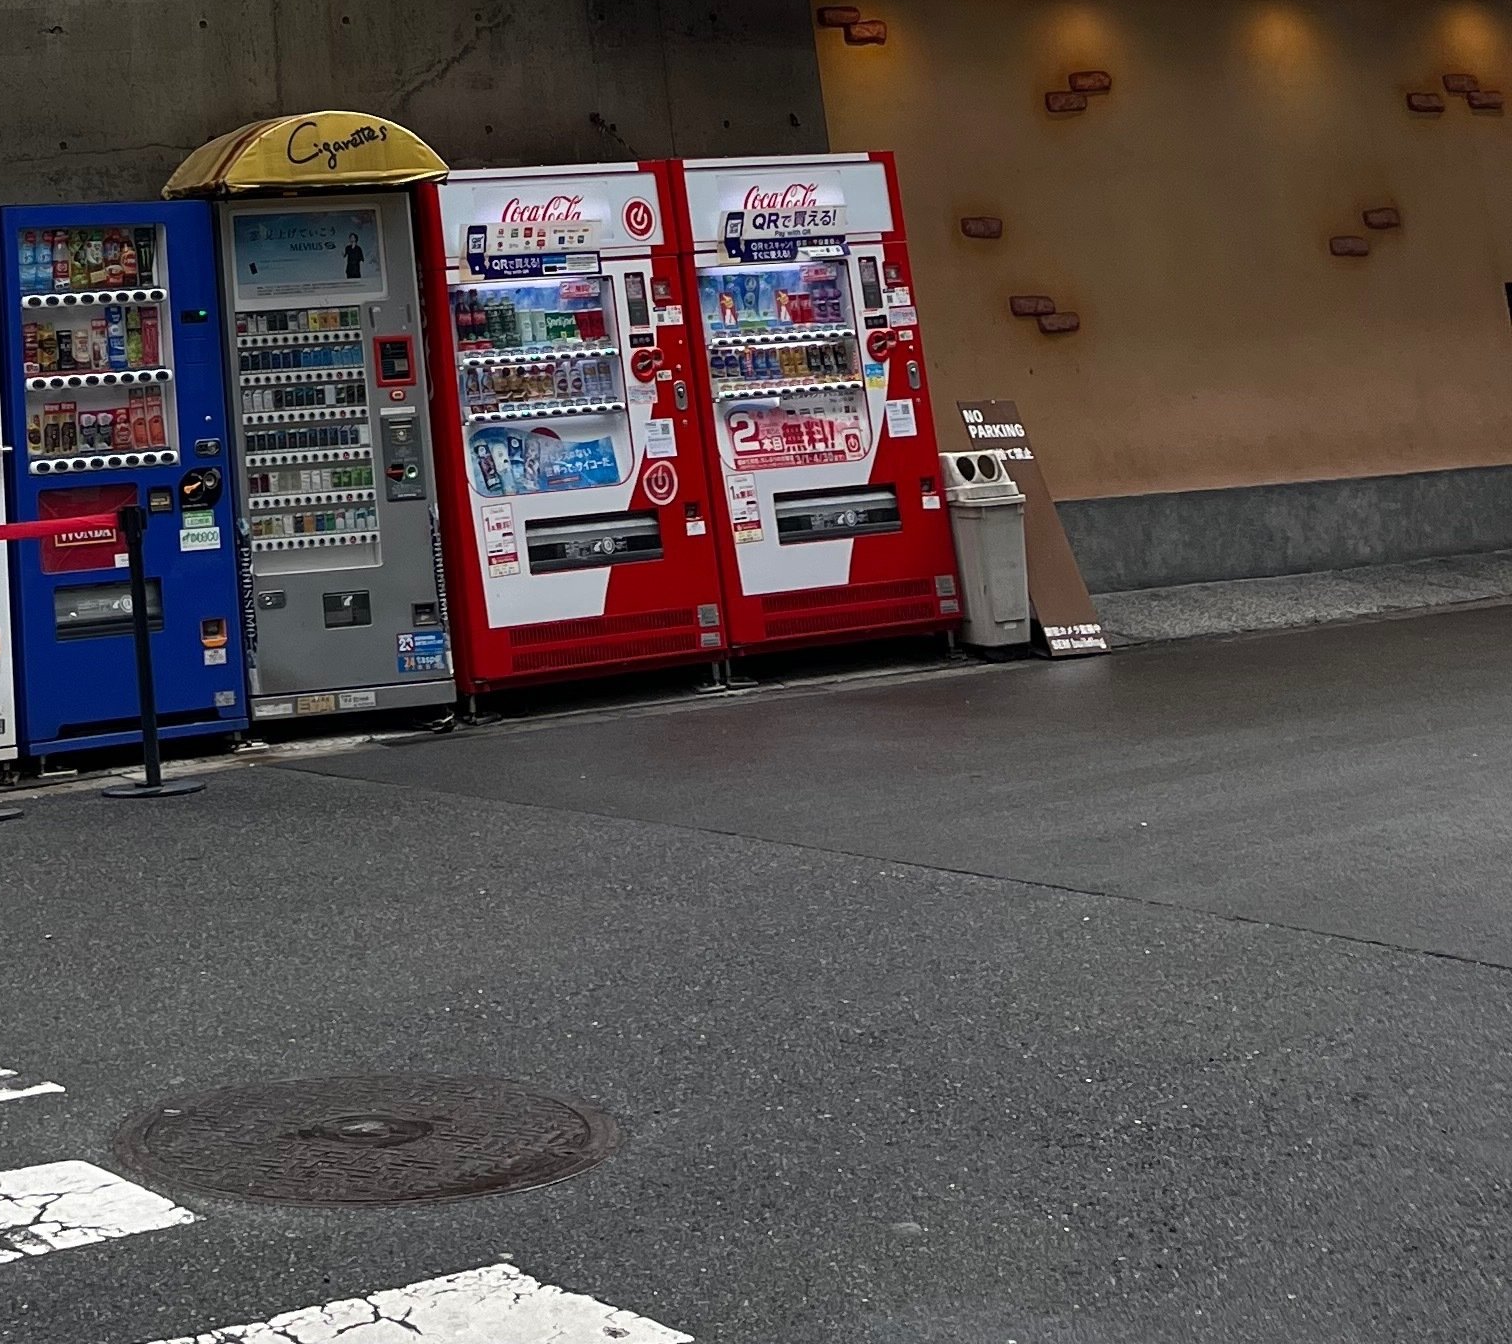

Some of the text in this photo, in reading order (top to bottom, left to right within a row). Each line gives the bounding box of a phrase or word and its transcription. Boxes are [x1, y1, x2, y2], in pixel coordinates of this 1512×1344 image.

[287, 121, 388, 170] Cigarettes
[752, 209, 837, 230] QRで買える!
[962, 410, 984, 424] NO
[968, 424, 1026, 440] PARKING
